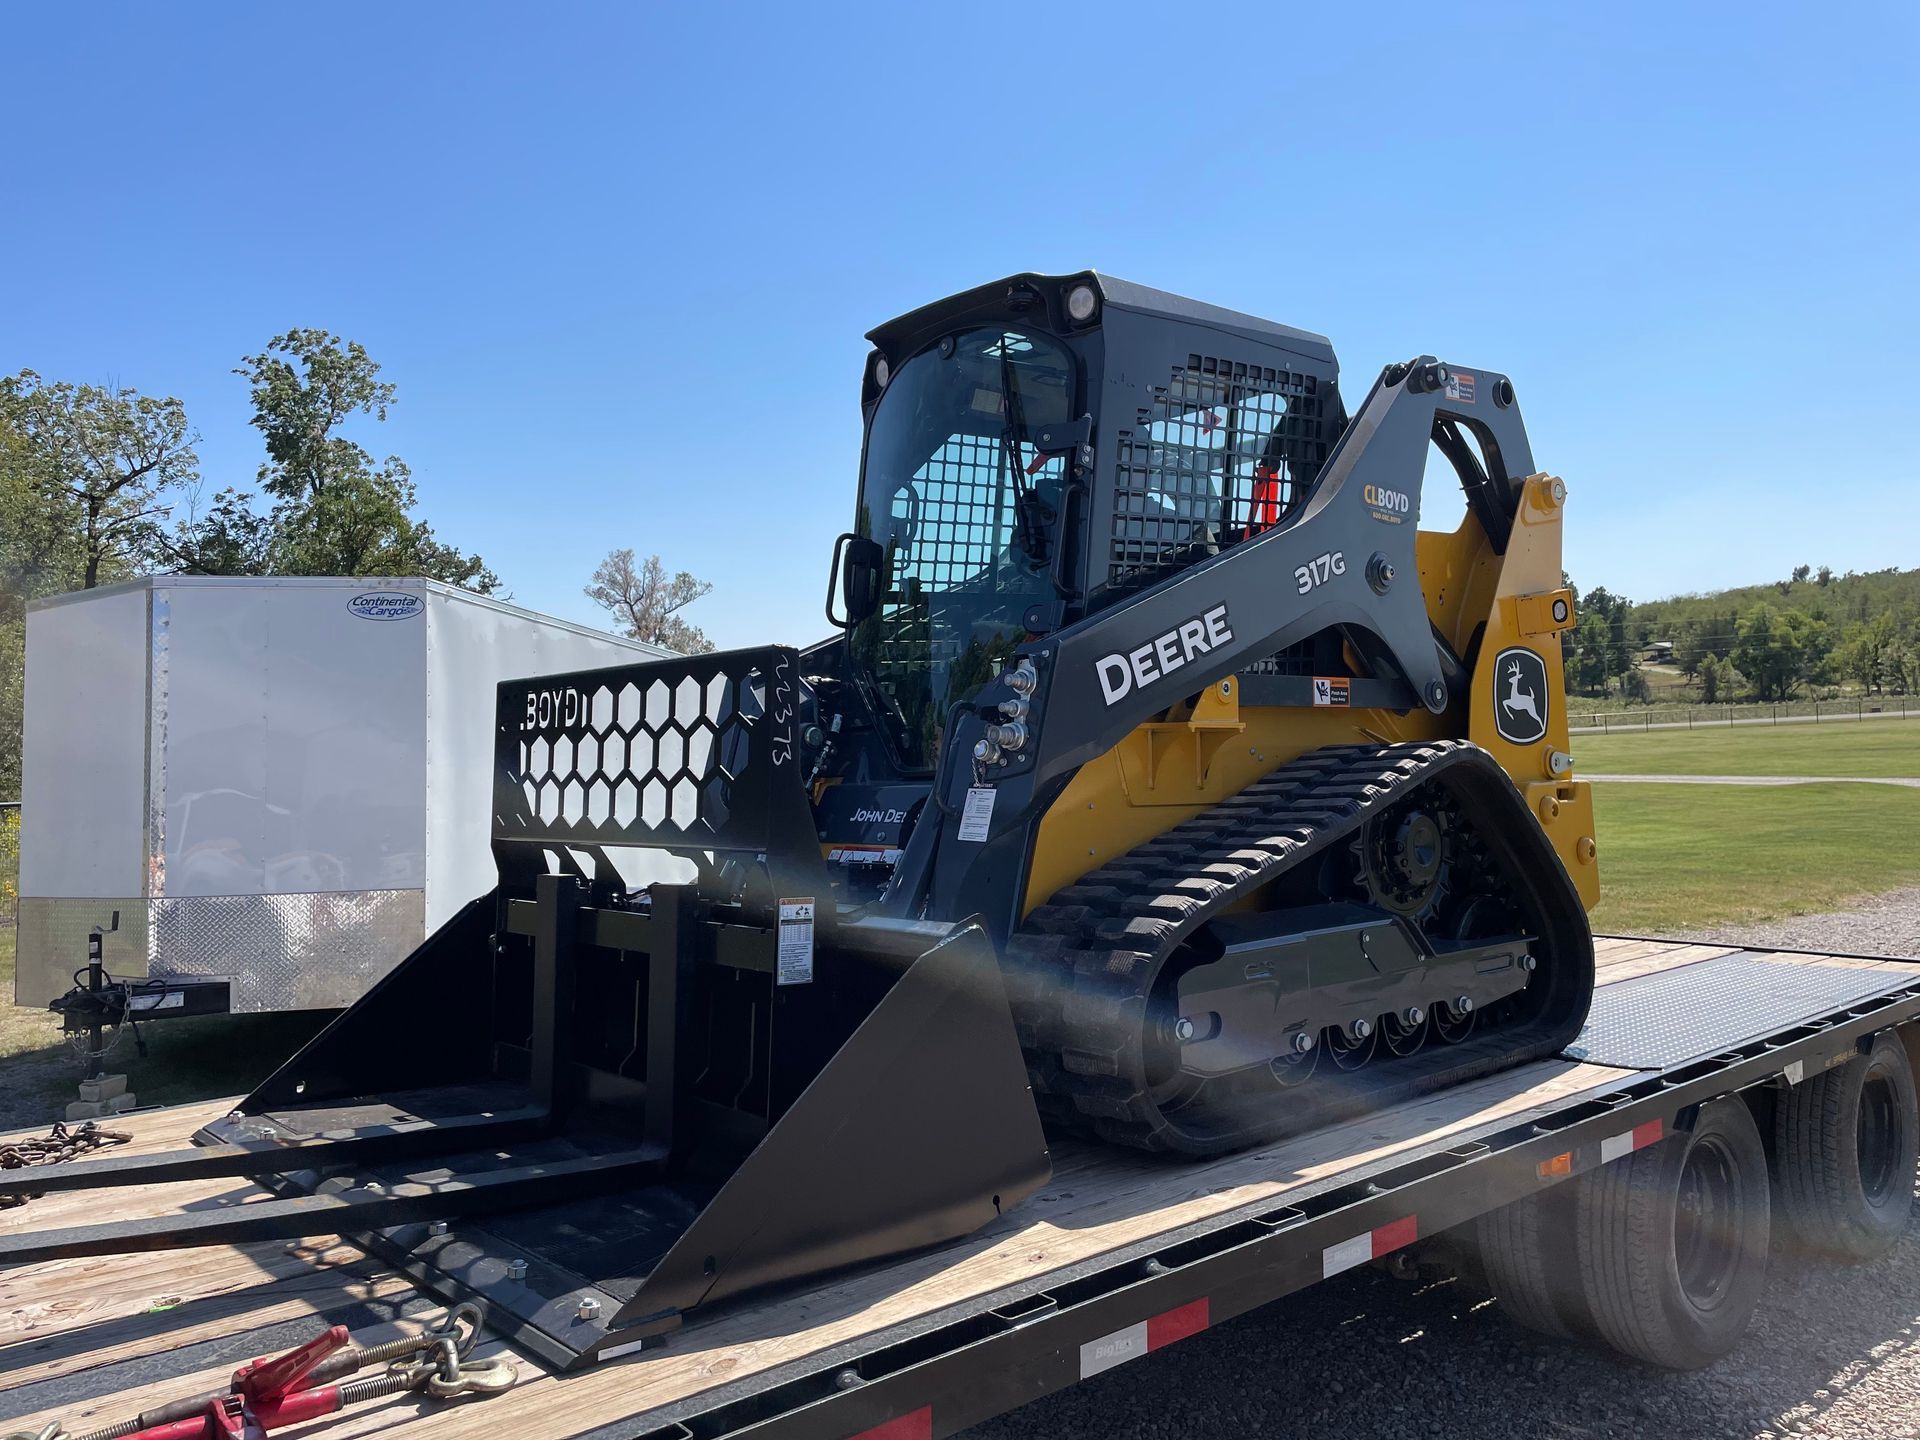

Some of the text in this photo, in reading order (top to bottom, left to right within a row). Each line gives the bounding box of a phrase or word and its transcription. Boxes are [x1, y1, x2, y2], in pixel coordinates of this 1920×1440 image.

[1294, 552, 1346, 595] 317G
[352, 596, 419, 607] Continental
[368, 606, 404, 618] Cargo
[1095, 604, 1233, 706] DEERE
[849, 807, 885, 822] JOHN
